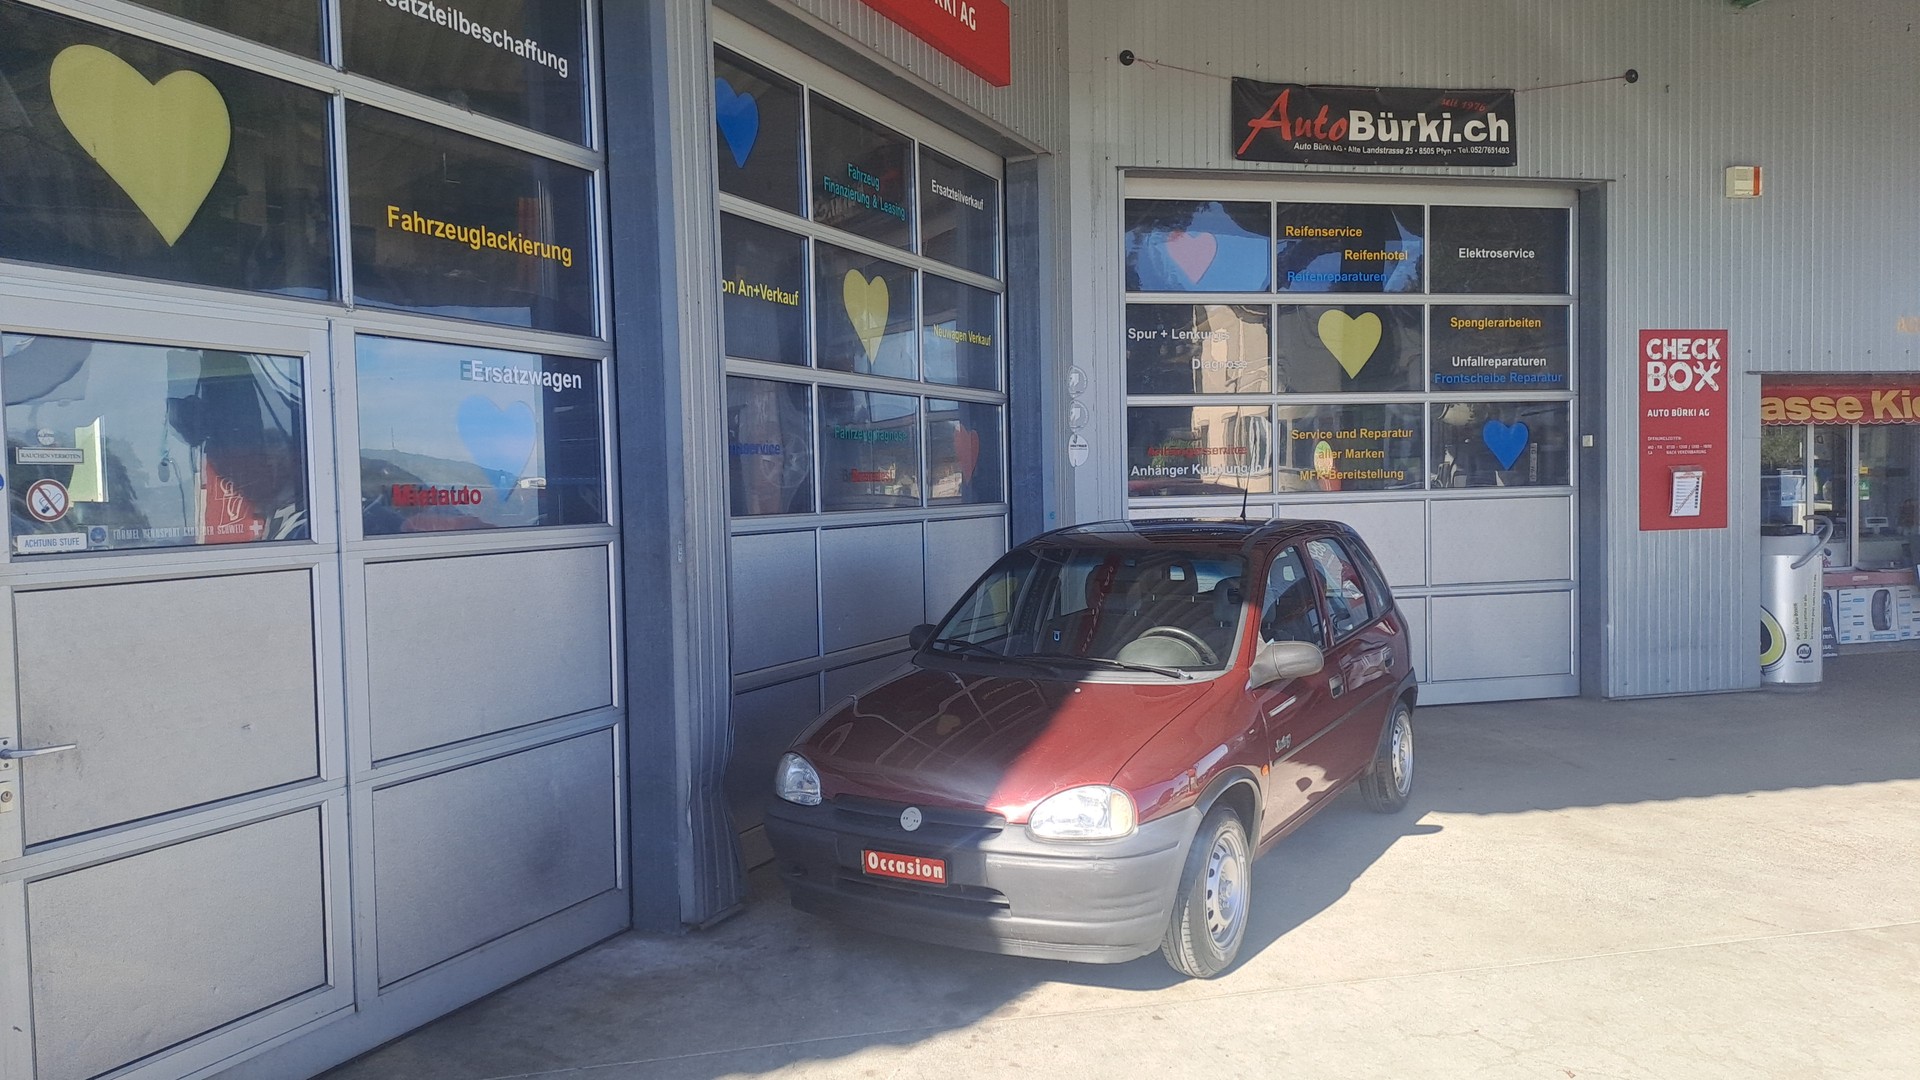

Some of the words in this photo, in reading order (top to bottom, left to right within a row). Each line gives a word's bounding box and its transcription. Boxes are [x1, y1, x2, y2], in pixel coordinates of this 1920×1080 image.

[960, 1, 976, 31] AG
[377, 0, 567, 78] satzteilbeschaffung
[1237, 88, 1348, 155] Auto
[1348, 110, 1510, 142] Bürki.ch
[1294, 142, 1311, 151] Auto
[1313, 142, 1331, 151] Bürki
[1348, 145, 1360, 153] Alte
[1362, 146, 1404, 154] Landstrasse
[1436, 147, 1451, 156] Pfyn
[848, 163, 880, 192] Fahrzeug
[823, 175, 870, 208] Finanzierung
[872, 195, 878, 208] &
[880, 196, 905, 221] Leasing
[931, 179, 984, 211] Ersatzteilverkauf
[387, 205, 572, 267] Fahrzeuglackierung
[1285, 225, 1363, 237] Reifenservice
[1344, 249, 1408, 260] Reifenhotel
[1458, 247, 1535, 259] Elektroservice
[1287, 271, 1388, 283] Reifenreparaturen
[738, 279, 799, 306] An+Verkauf
[1450, 317, 1541, 330] Spenglerarbeiten
[933, 323, 967, 344] Neuwagen
[967, 330, 992, 347] Verkauf
[1128, 328, 1157, 341] Spur
[1160, 330, 1168, 338] +
[1646, 338, 1721, 360] CHECK
[1191, 358, 1248, 372] Diagnose
[1452, 356, 1547, 369] Unfallreparaturen
[470, 359, 582, 392] Ersatzwagen
[1434, 373, 1506, 383] Frontscheibe
[1510, 372, 1563, 384] Reparatur
[1647, 361, 1721, 392] BOX
[1647, 409, 1669, 417] AUTO
[1671, 407, 1697, 417] BÜRKI
[1698, 408, 1710, 417] AG
[1291, 429, 1332, 440] Service
[1336, 429, 1356, 439] und
[1360, 428, 1413, 440] Reparatur
[1318, 449, 1342, 458] aller
[1345, 449, 1385, 458] Marken
[1130, 464, 1188, 478] Anhänger
[1300, 469, 1404, 480] MFK-Bereitstellung
[217, 524, 244, 535] SCHWEIZ
[25, 538, 57, 548] ACHTUNG
[59, 537, 80, 547] STUFE
[867, 851, 943, 879] Occasion
